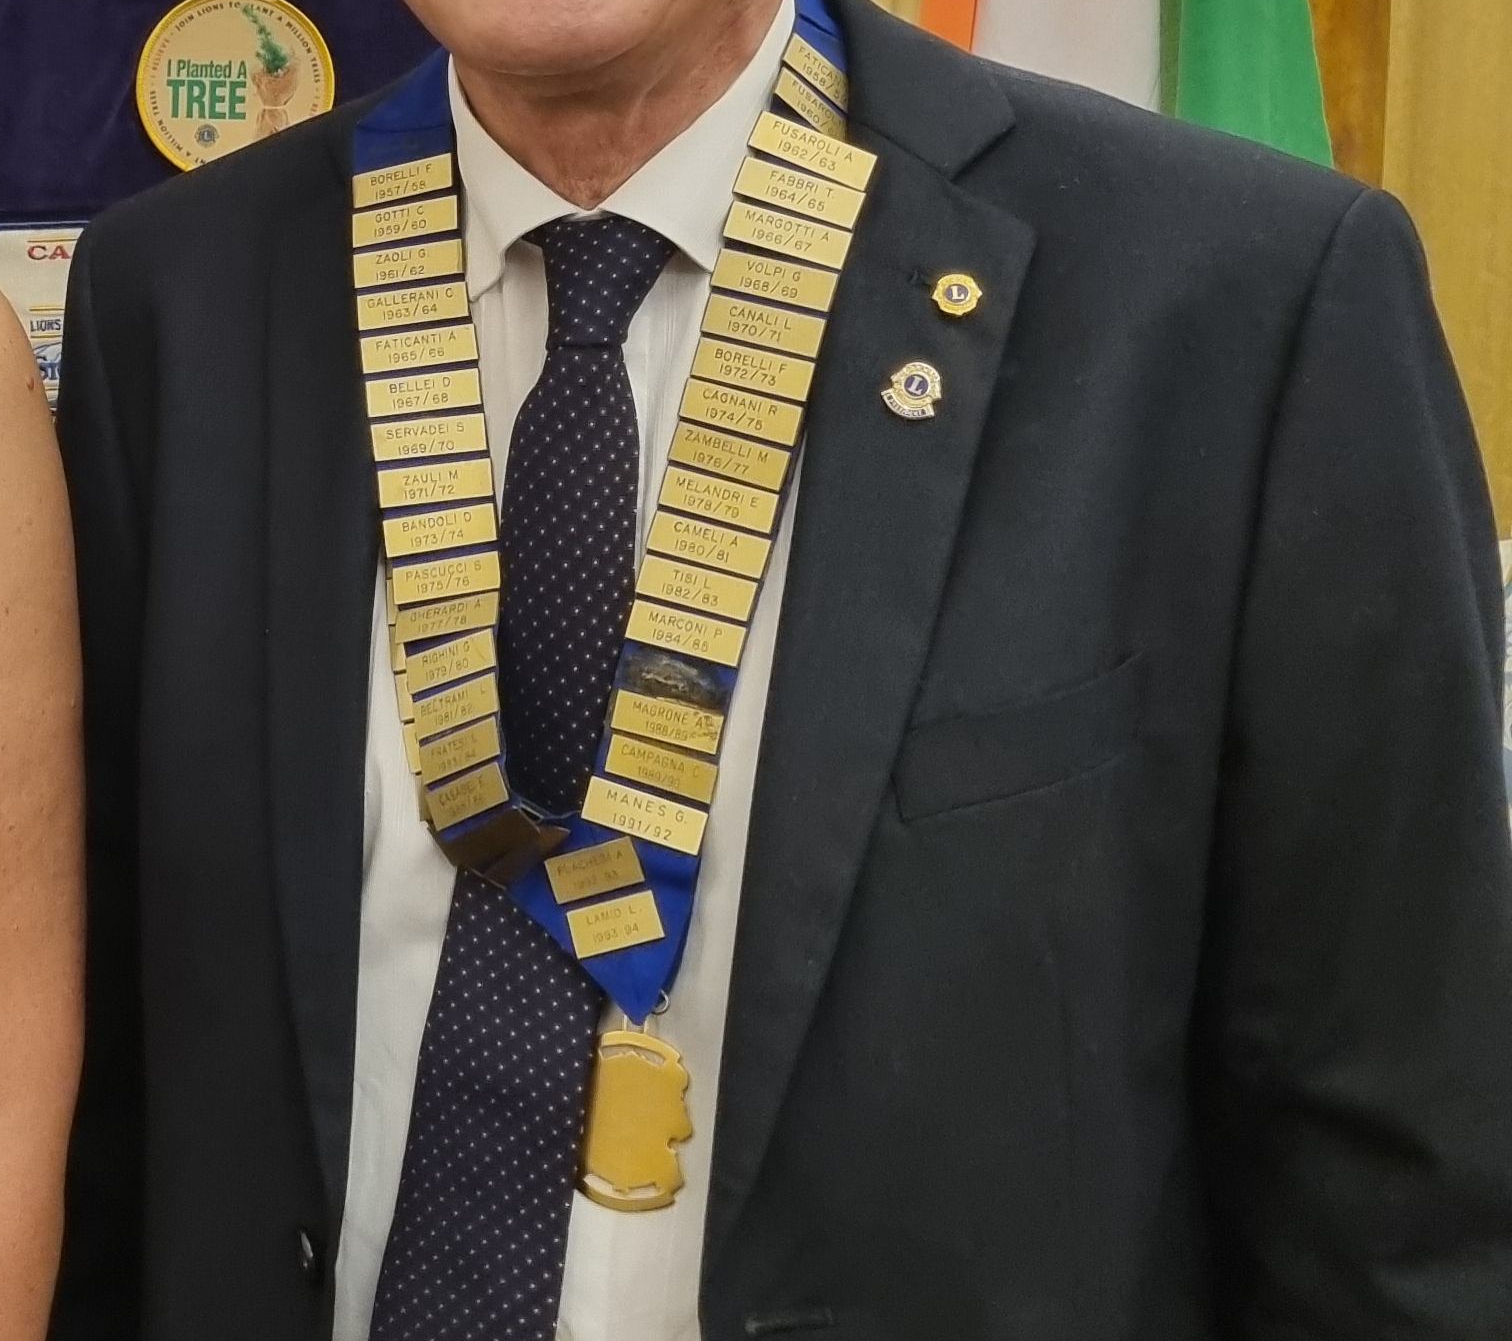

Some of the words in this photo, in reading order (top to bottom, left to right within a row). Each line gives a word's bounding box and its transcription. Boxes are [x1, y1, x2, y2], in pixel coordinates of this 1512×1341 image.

[175, 14, 195, 32] JOIN
[198, 3, 224, 17] LIONS
[285, 22, 313, 54] MILLION
[167, 59, 171, 77] I
[178, 59, 232, 78] Planted
[237, 60, 247, 78] A
[166, 79, 246, 120] TREE
[772, 121, 841, 155] FUSAROLI
[777, 140, 837, 172] 1962/63
[370, 166, 420, 186] BORELLI
[770, 170, 819, 194] FABBRI
[765, 185, 825, 211] 1964/65
[375, 208, 410, 223] GOTTI
[744, 210, 816, 237] MARGOTTI
[752, 227, 812, 252] 1966/67
[376, 250, 412, 265] ZAOLI
[376, 264, 425, 281] 1961/62
[747, 261, 786, 278] VOLPI
[739, 276, 798, 298] 1968/69
[367, 290, 439, 308] GALLERANI
[383, 300, 437, 320] 1963/64
[729, 306, 778, 325] CANALI
[30, 319, 61, 332] LIONS
[727, 320, 781, 342] 1970/71
[375, 334, 442, 351] FATICANTI
[449, 331, 457, 341] A
[388, 347, 445, 364] 1965/66
[715, 349, 772, 370] BORELLI
[719, 364, 776, 387] 1972/73
[389, 379, 435, 394] BELLEI
[393, 392, 449, 409] 1967/68
[703, 388, 762, 411] CAGNANI
[705, 406, 762, 431] 1974/75
[386, 423, 449, 440] SERVADEI
[398, 439, 455, 455] 1969/70
[685, 429, 751, 459] ZAMBELLI
[693, 451, 750, 475] 1976/77
[403, 473, 441, 486] ZAULI
[676, 476, 745, 503] MELANDRI
[404, 481, 455, 500] 1971/72
[683, 494, 739, 518] 1978/79
[402, 514, 456, 533] BANDOLI
[673, 522, 724, 543] CAMELI
[411, 529, 464, 547] 1973/74
[675, 539, 729, 562] 1980/81
[405, 563, 467, 582] PASCUCCI
[673, 570, 698, 588] TIBI
[661, 583, 719, 606] 1982/83
[648, 611, 707, 635] MARCONI
[606, 789, 667, 816] MANES
[611, 812, 673, 841] 1991/92
